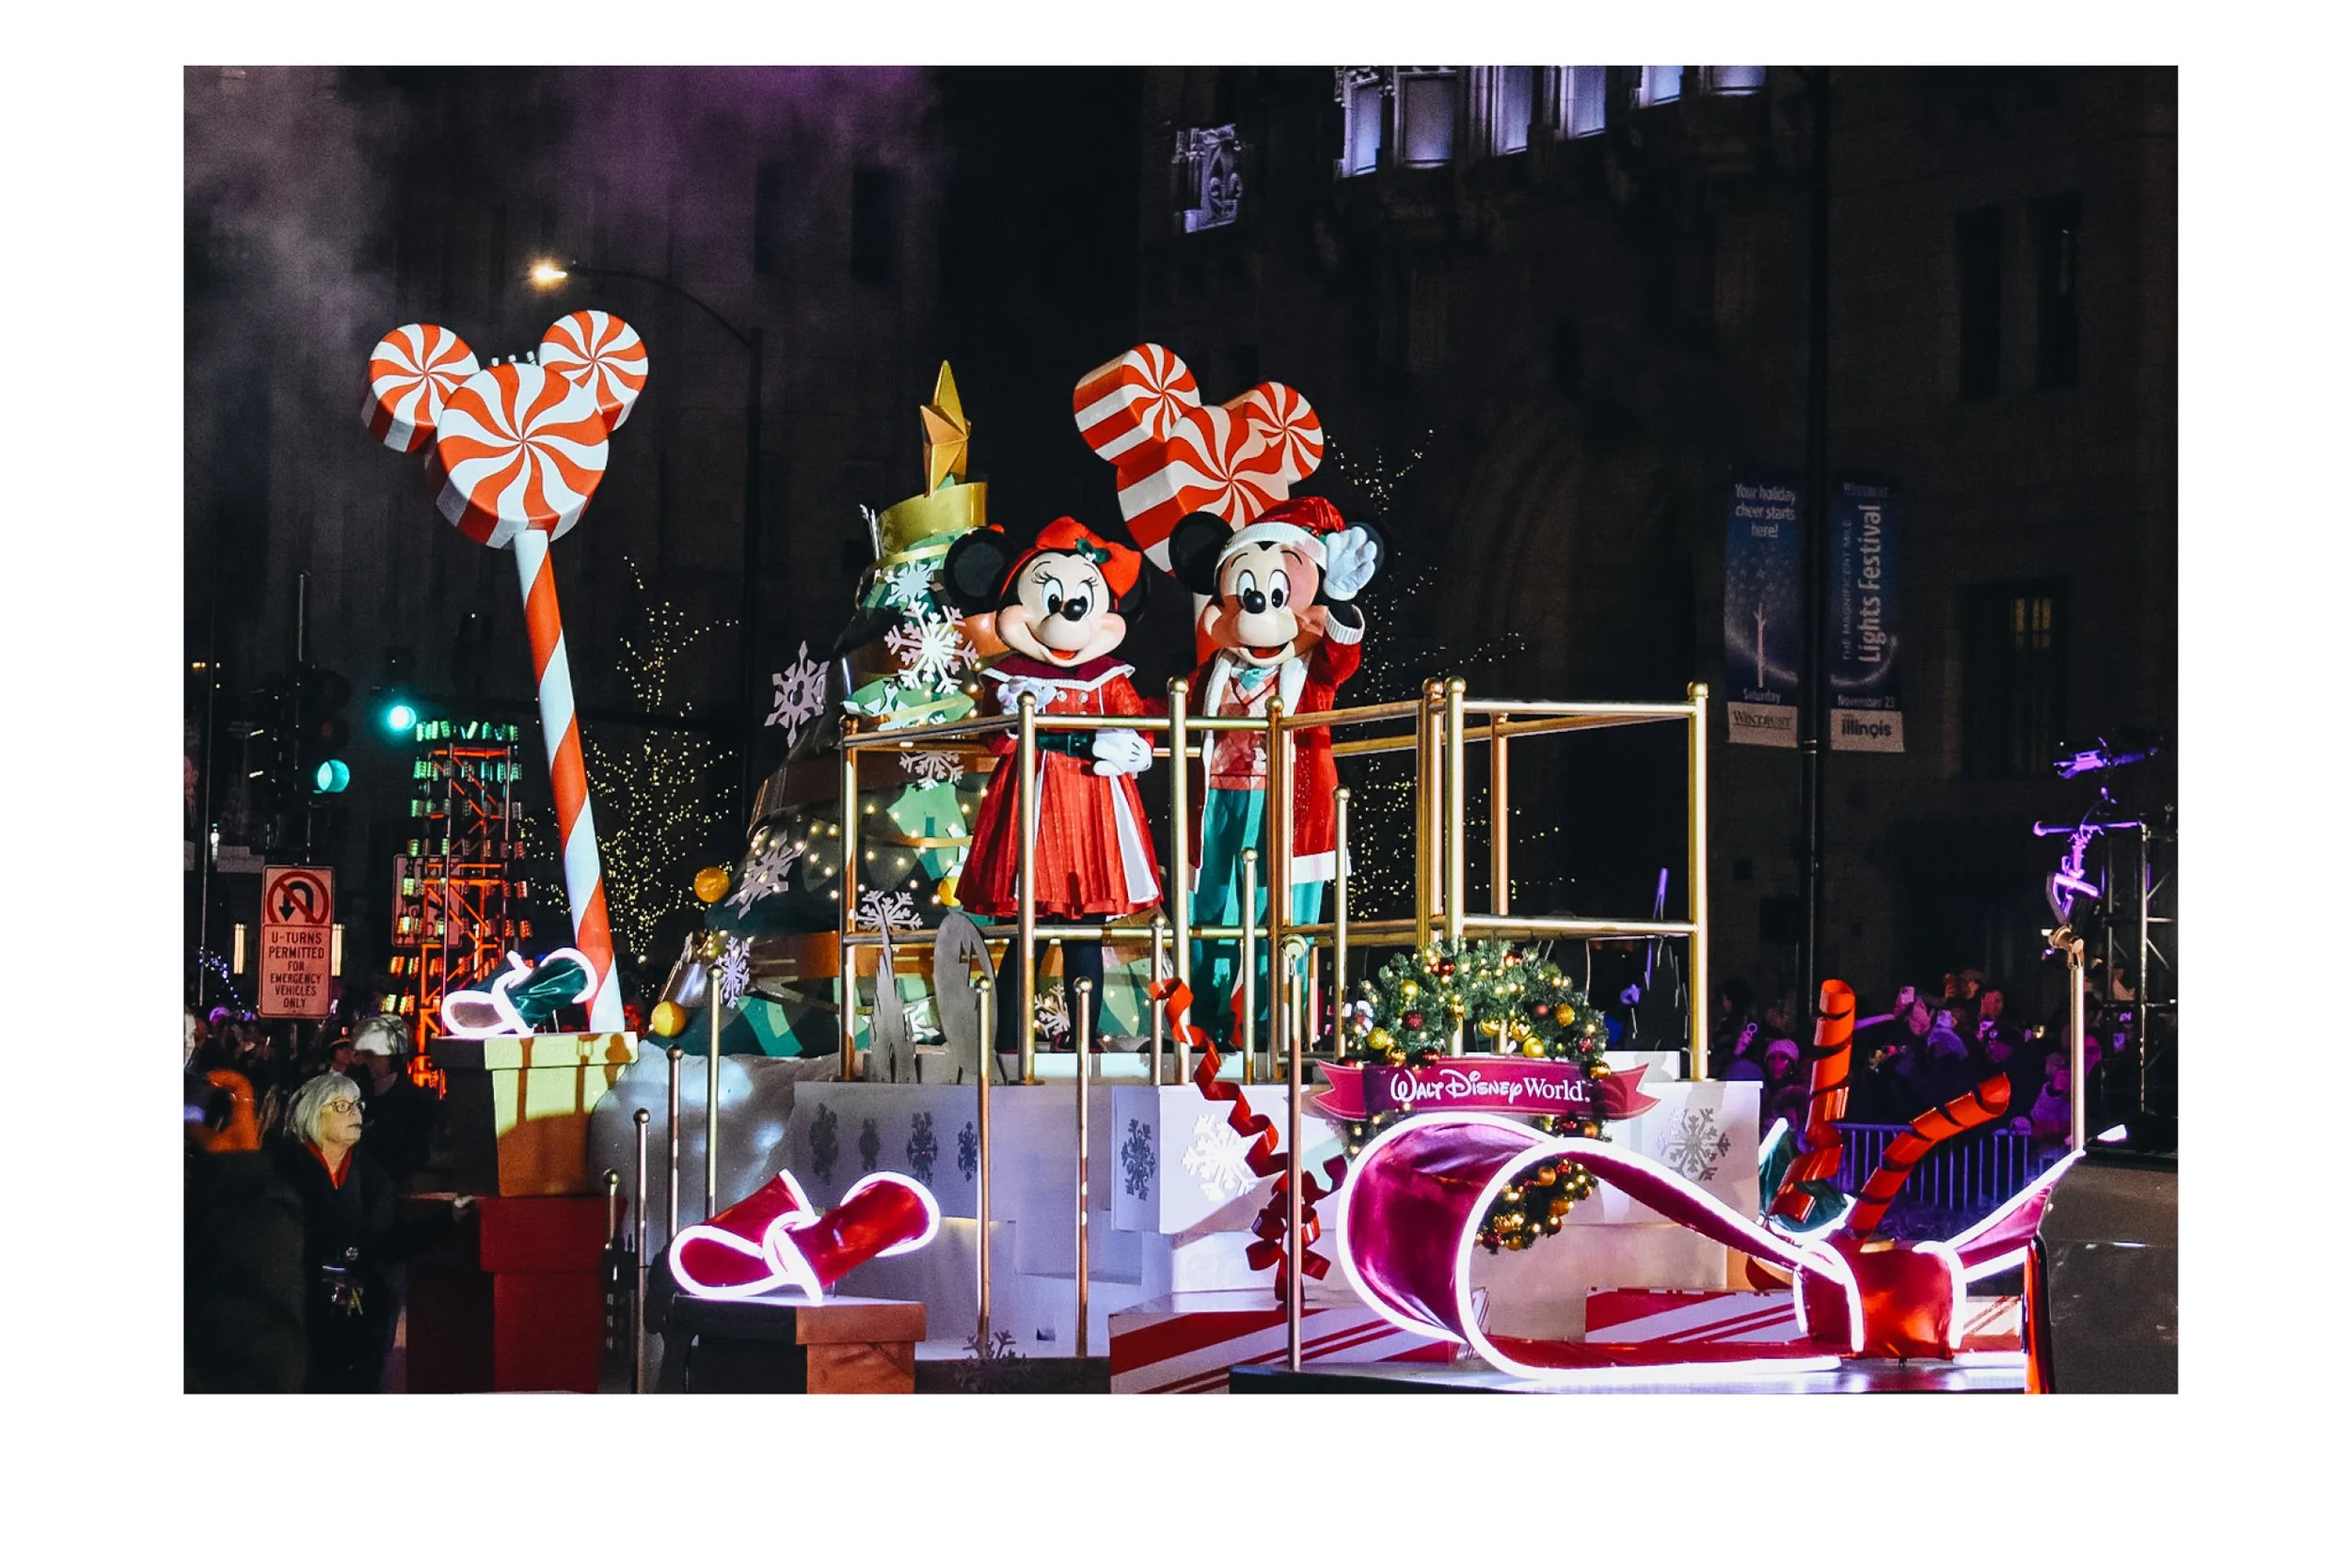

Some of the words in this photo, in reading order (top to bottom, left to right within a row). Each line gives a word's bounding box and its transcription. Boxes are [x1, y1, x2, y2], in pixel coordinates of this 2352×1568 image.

[1735, 483, 1757, 499] Your
[1758, 484, 1796, 506] holiday
[1735, 502, 1764, 518] cheer
[1765, 506, 1796, 521] starts
[1751, 522, 1778, 538] here!
[1857, 504, 1882, 590] Festival
[1857, 596, 1887, 662] Lights
[1742, 688, 1782, 704] Saturday
[1837, 694, 1882, 707] November
[272, 931, 322, 944] U-TURNS
[269, 946, 325, 958] PERMITTED
[288, 960, 305, 972] FOR
[270, 974, 322, 985] EMERGENCY
[275, 986, 317, 997] VEHICLES
[283, 998, 308, 1008] ONLY
